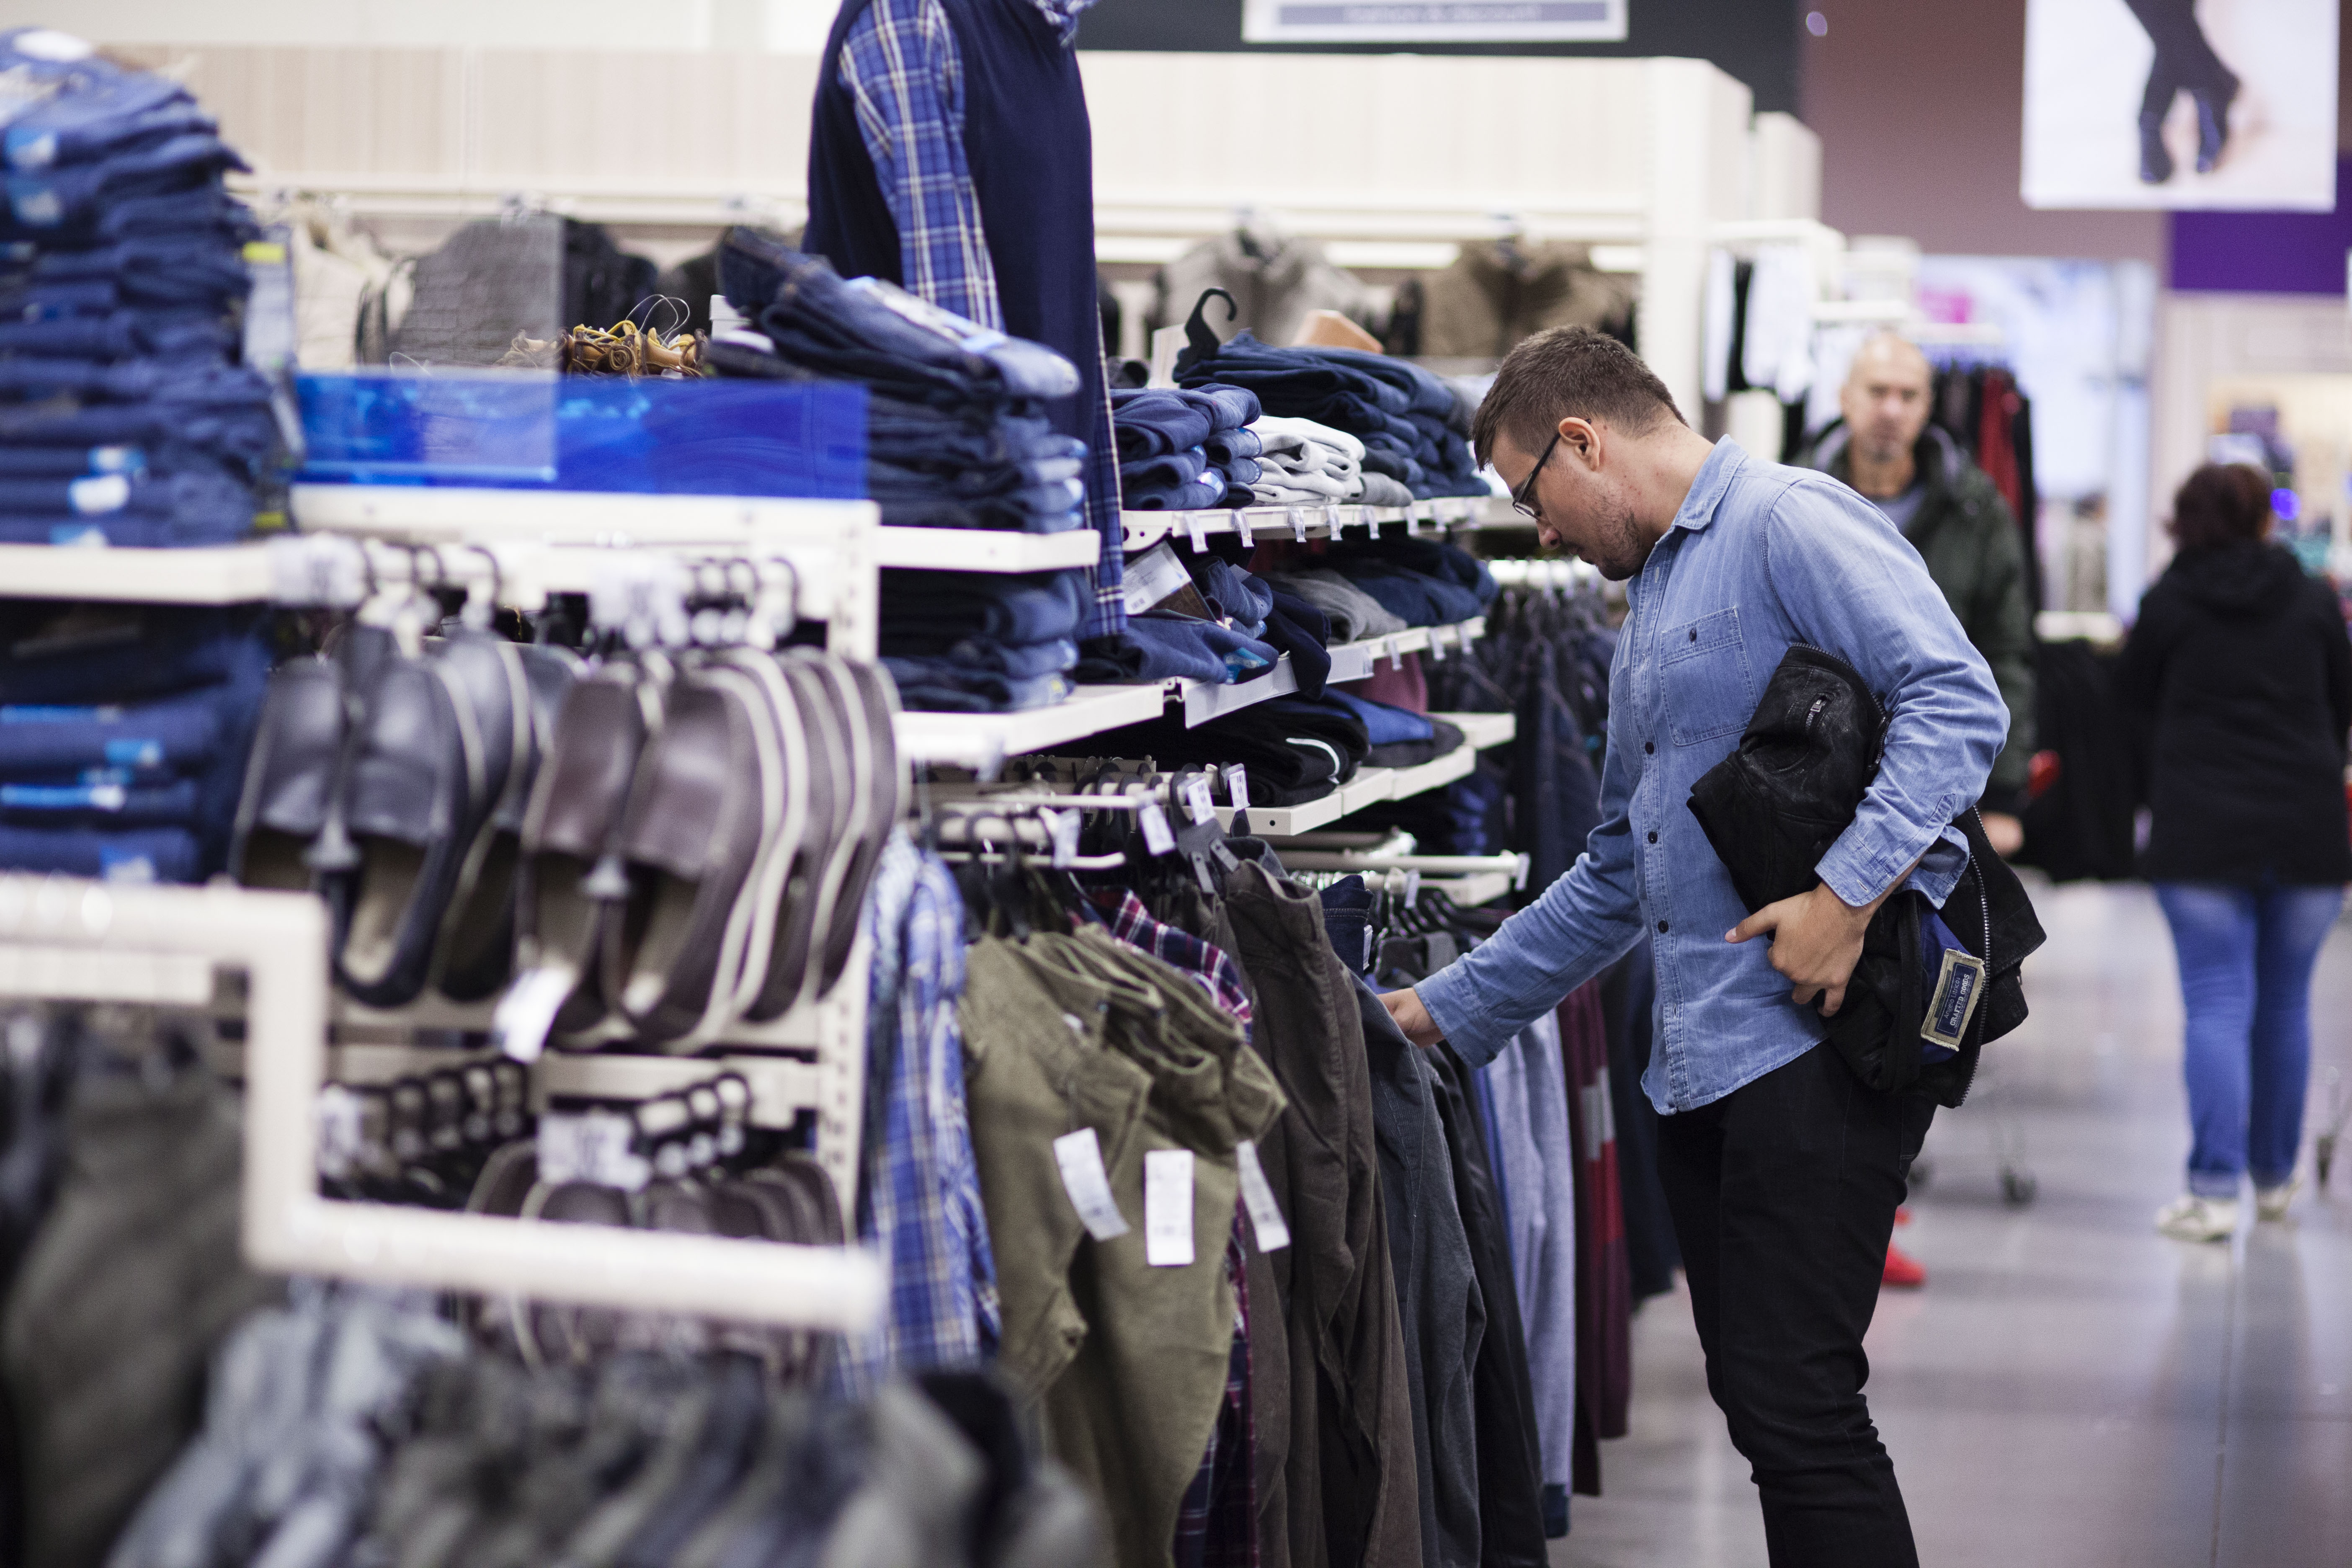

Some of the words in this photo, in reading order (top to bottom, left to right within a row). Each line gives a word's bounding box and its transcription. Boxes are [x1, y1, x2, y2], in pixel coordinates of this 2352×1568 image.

[1944, 999, 1955, 1019] Angelo
[1951, 980, 1960, 998] Litrico
[1950, 996, 1964, 1026] CRAFTED
[1960, 974, 1970, 995] GOODS
